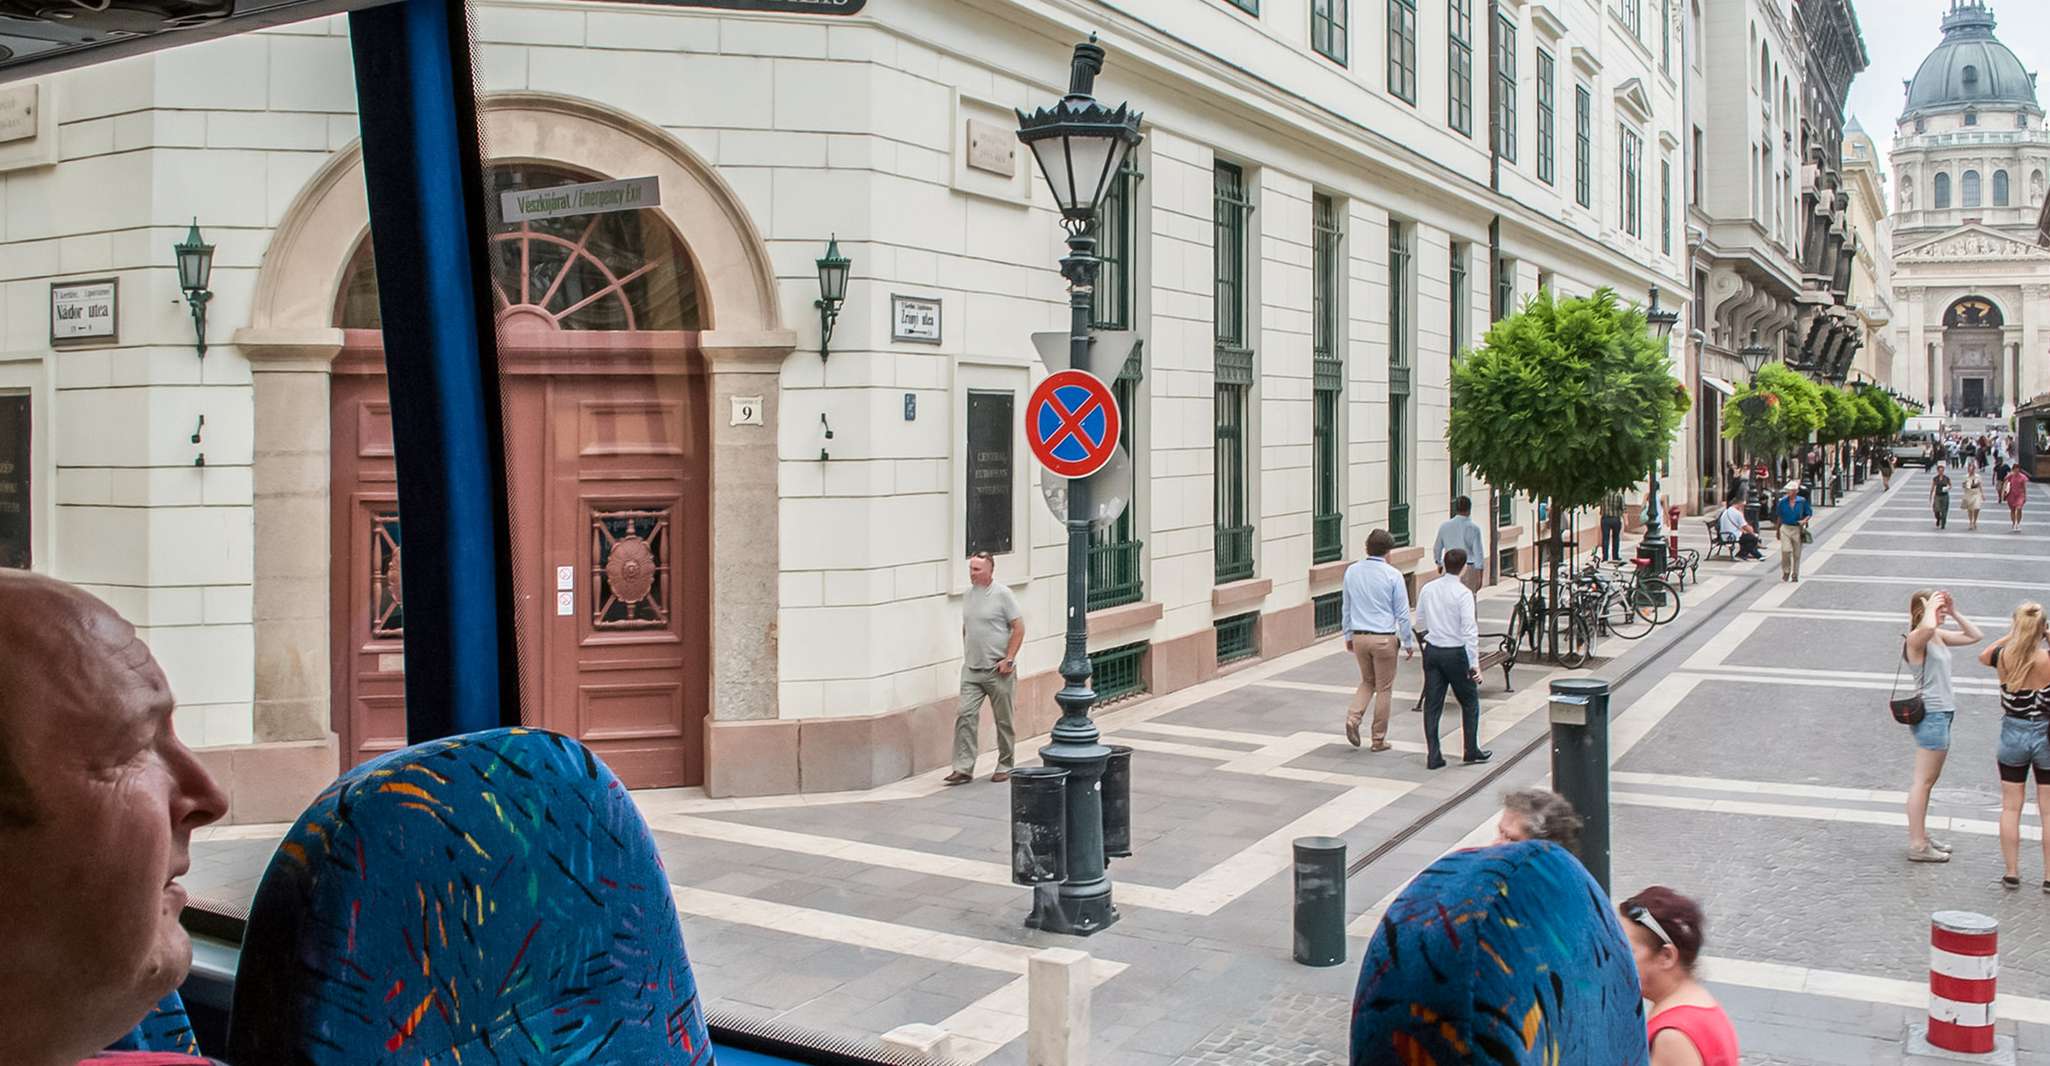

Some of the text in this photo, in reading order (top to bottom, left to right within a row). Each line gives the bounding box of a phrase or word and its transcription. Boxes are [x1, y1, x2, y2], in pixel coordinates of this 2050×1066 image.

[579, 189, 622, 209] Emergency
[626, 184, 640, 201] Exit
[57, 304, 108, 320] Nádor utca
[922, 312, 933, 325] utca
[743, 407, 752, 420] 9
